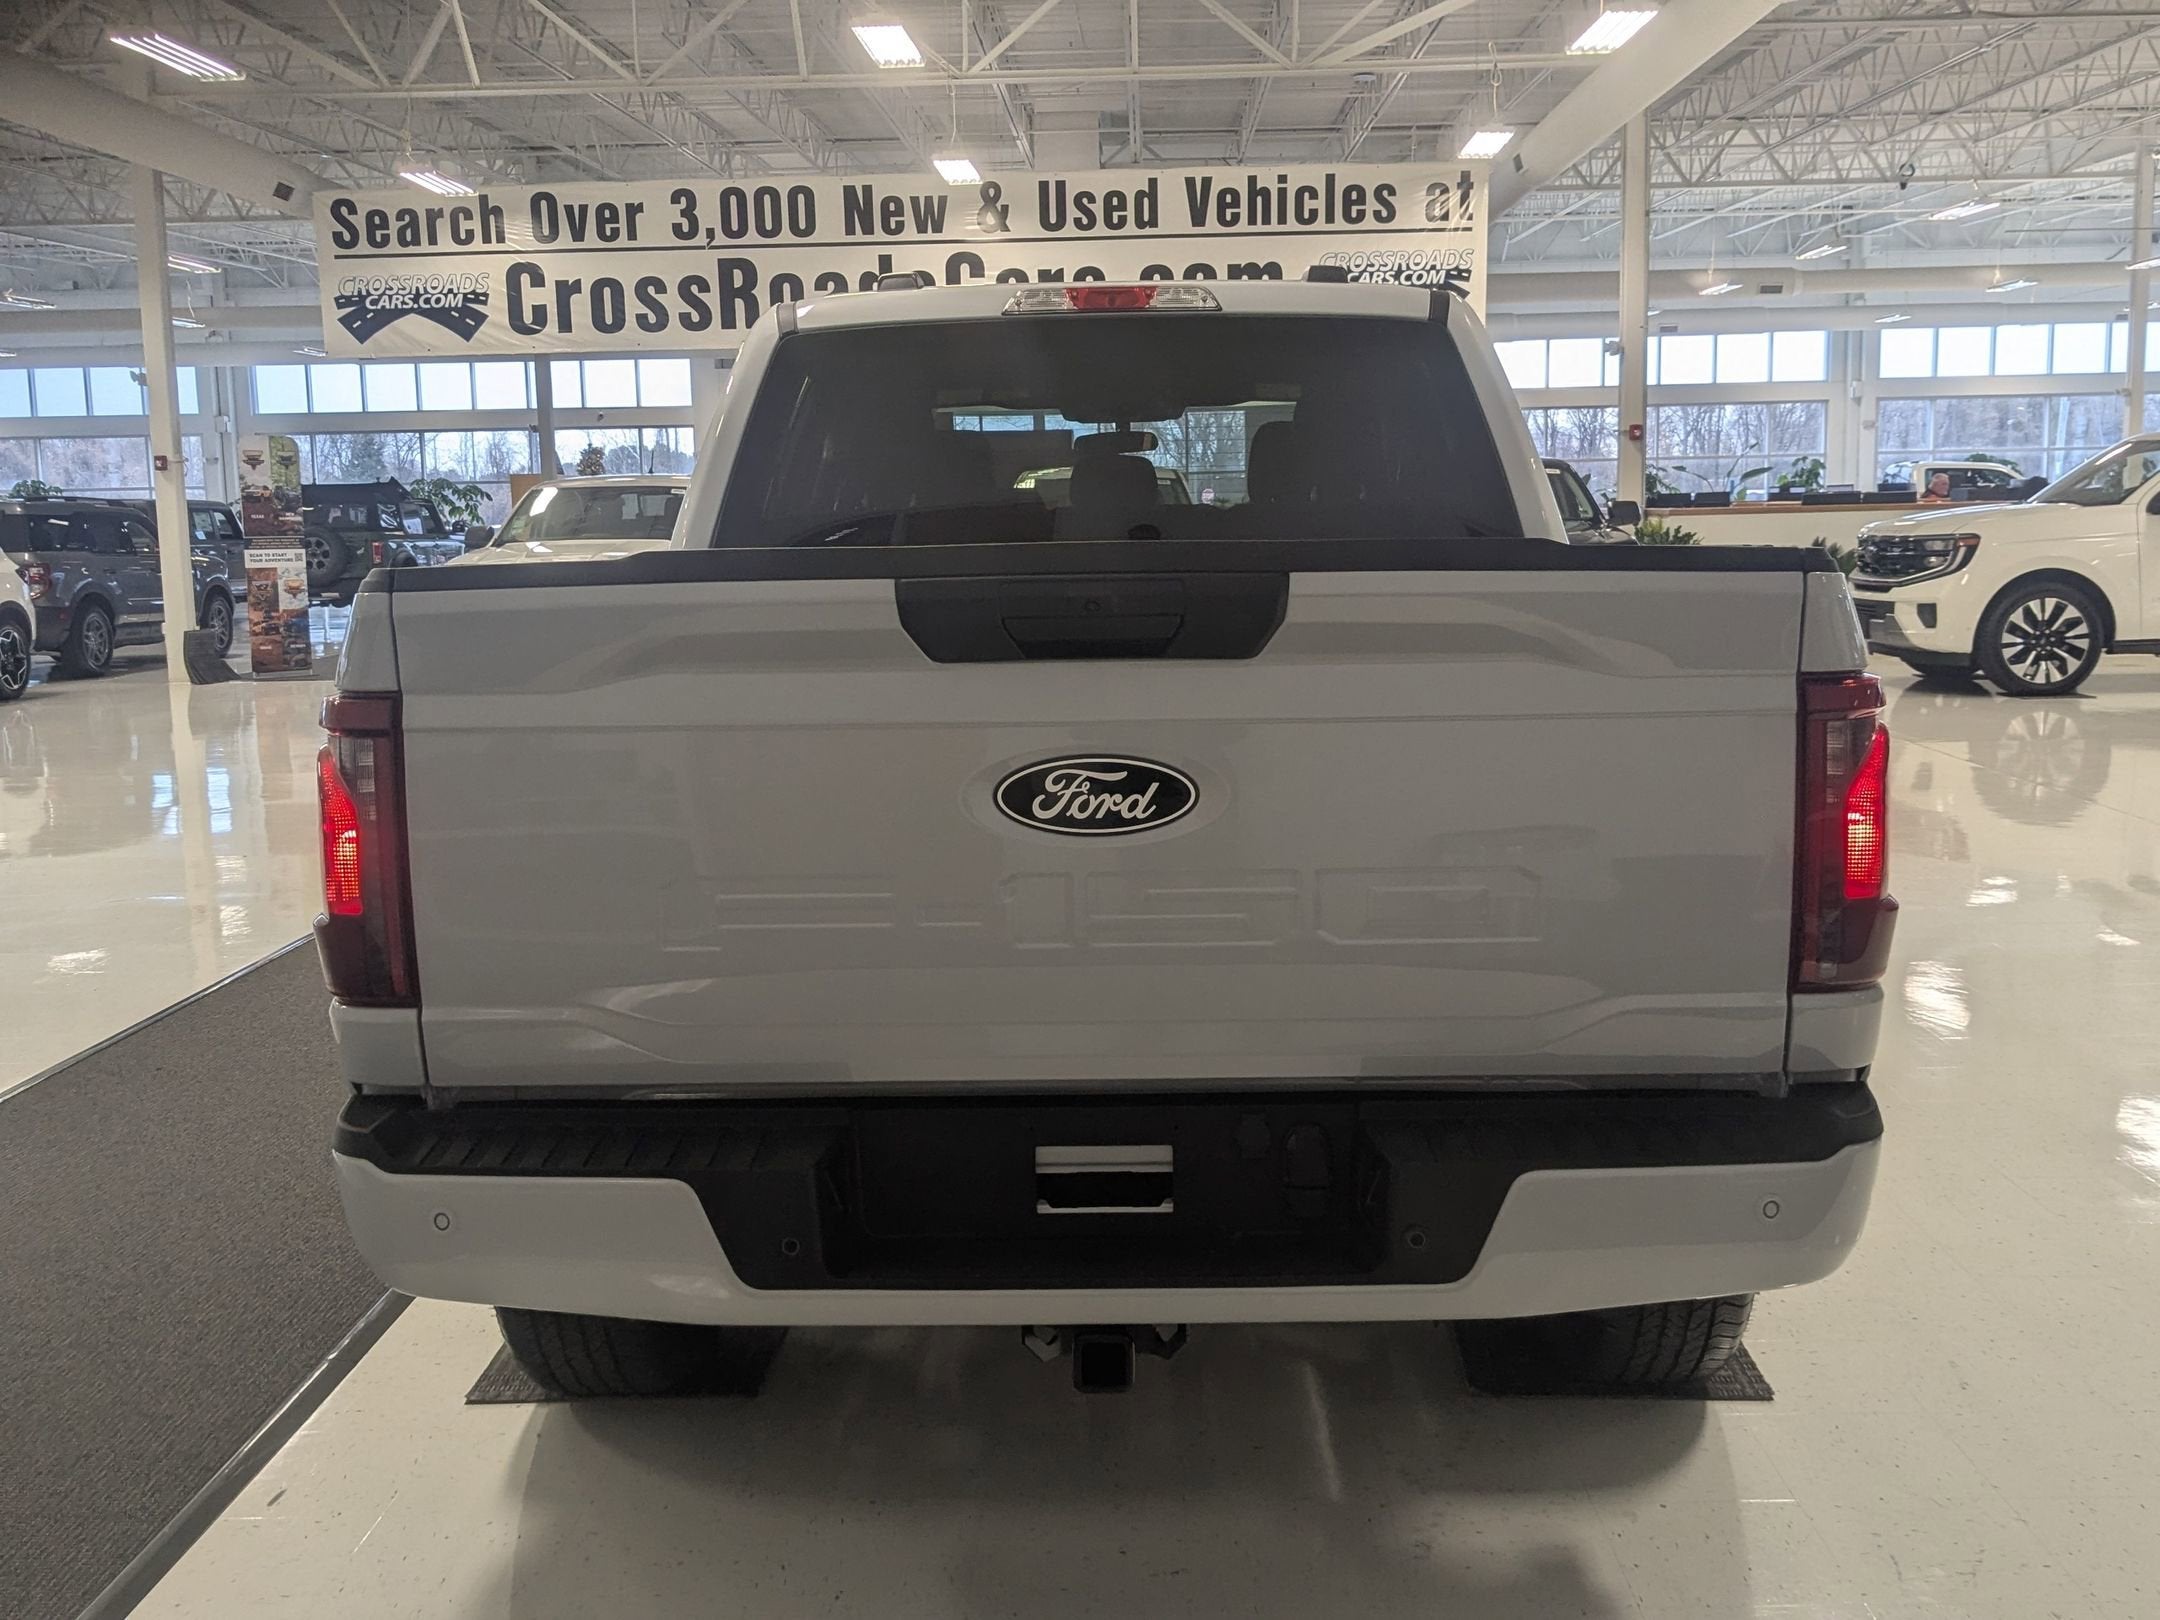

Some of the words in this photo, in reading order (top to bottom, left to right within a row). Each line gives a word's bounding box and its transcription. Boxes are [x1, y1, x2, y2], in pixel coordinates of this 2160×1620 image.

[330, 193, 506, 250] Search
[529, 191, 645, 244] Over
[670, 184, 817, 247] 3,000
[842, 184, 948, 236] New
[977, 180, 1012, 233] &
[1038, 177, 1159, 232] Used
[1184, 173, 1397, 228] Vehicles
[1425, 170, 1474, 223] at
[338, 272, 490, 296] CROSSROADS
[365, 293, 464, 310] CARS.COM
[1032, 768, 1160, 820] Ford
